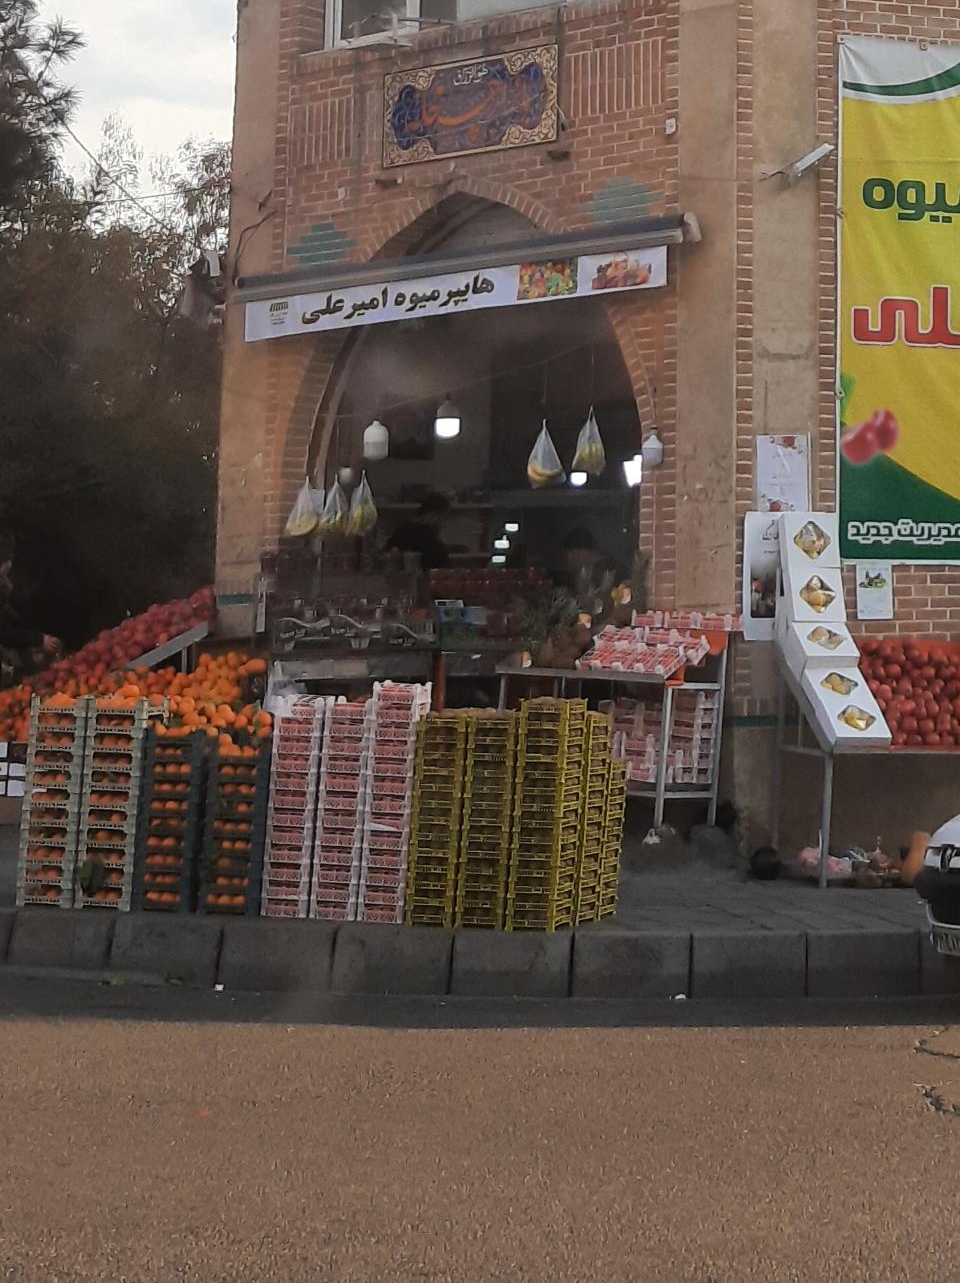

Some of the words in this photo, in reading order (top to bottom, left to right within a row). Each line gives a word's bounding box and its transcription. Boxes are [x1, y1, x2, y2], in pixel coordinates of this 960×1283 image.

[394, 287, 441, 312] میوه
[438, 273, 495, 307] هایپر
[848, 521, 894, 544] جدید
